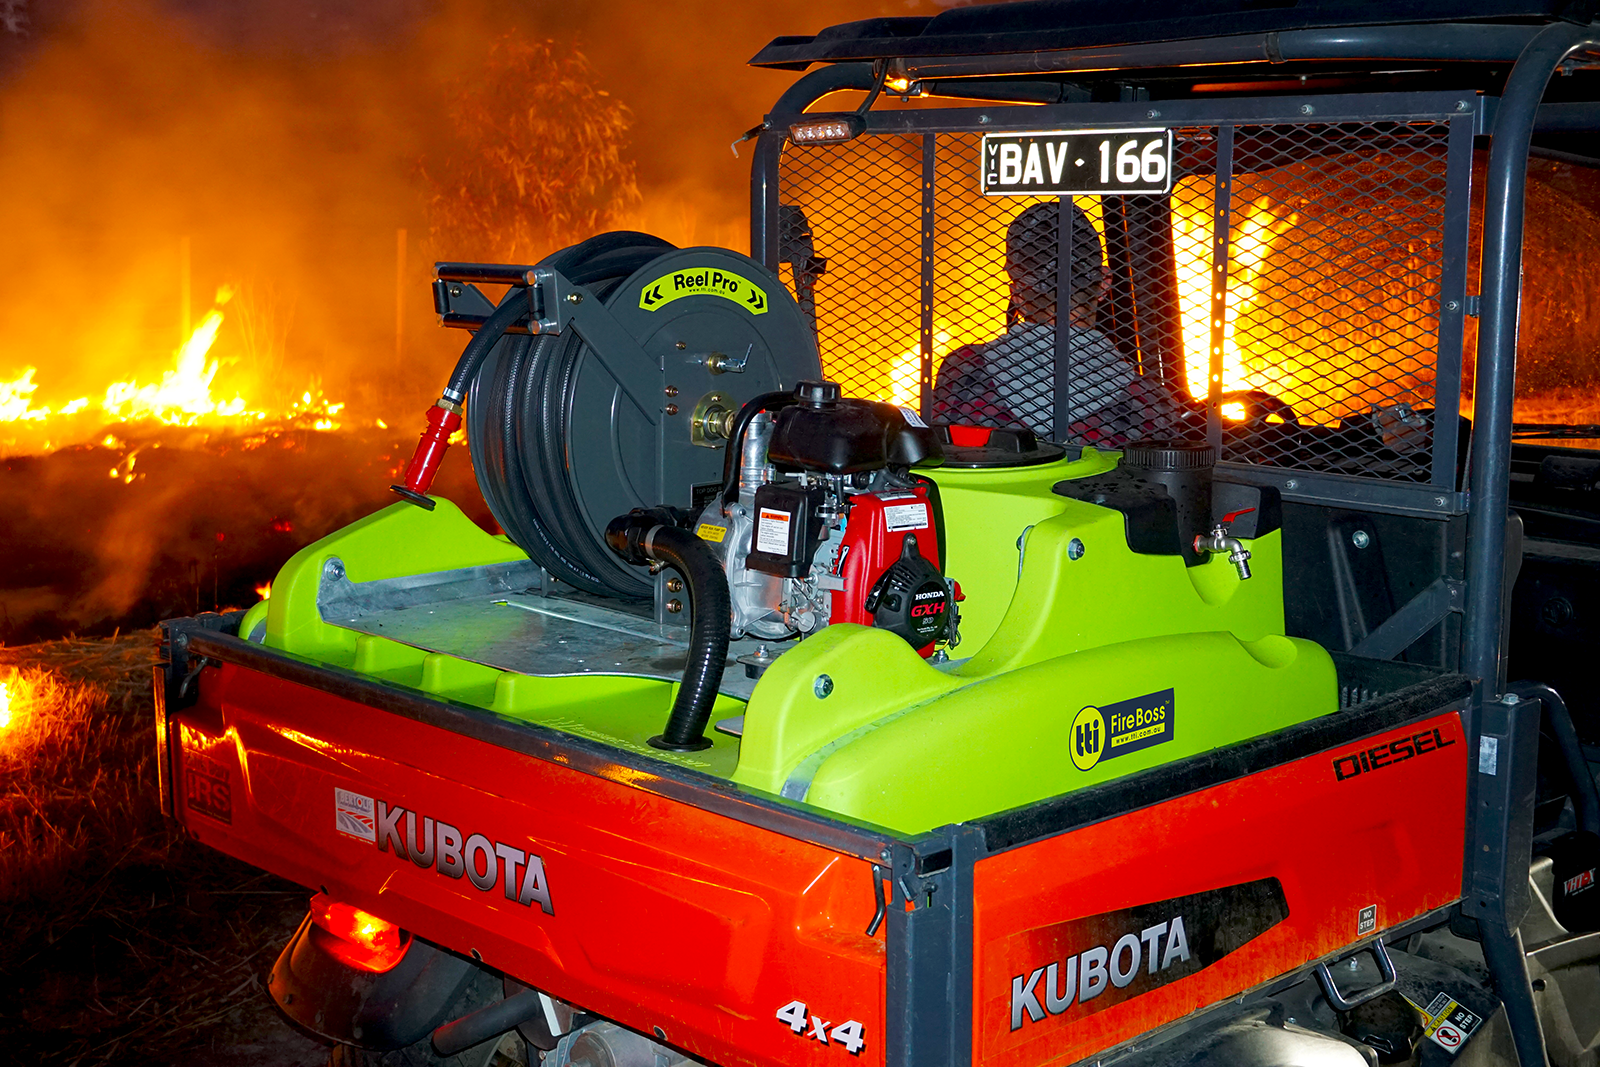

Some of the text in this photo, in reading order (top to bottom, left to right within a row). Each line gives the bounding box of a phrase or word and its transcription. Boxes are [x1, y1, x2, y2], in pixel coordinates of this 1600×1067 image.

[988, 143, 998, 185] VIC
[1000, 139, 1166, 185] BAV 166
[673, 270, 738, 293] Reel Pro
[915, 590, 945, 600] HONDA
[911, 601, 946, 617] GXH
[1111, 705, 1166, 734] FireBoss
[1076, 719, 1099, 757] tti
[1116, 726, 1161, 744] www.tti.com.au
[1332, 728, 1456, 782] DIESEL
[376, 799, 555, 917] KUBOTA
[1360, 918, 1374, 930] STEP
[1363, 910, 1373, 919] NO
[1010, 915, 1191, 1032] KUBOTA
[1434, 1006, 1453, 1027] CAUTION
[1454, 1011, 1465, 1022] NO
[1459, 1014, 1474, 1030] STEP
